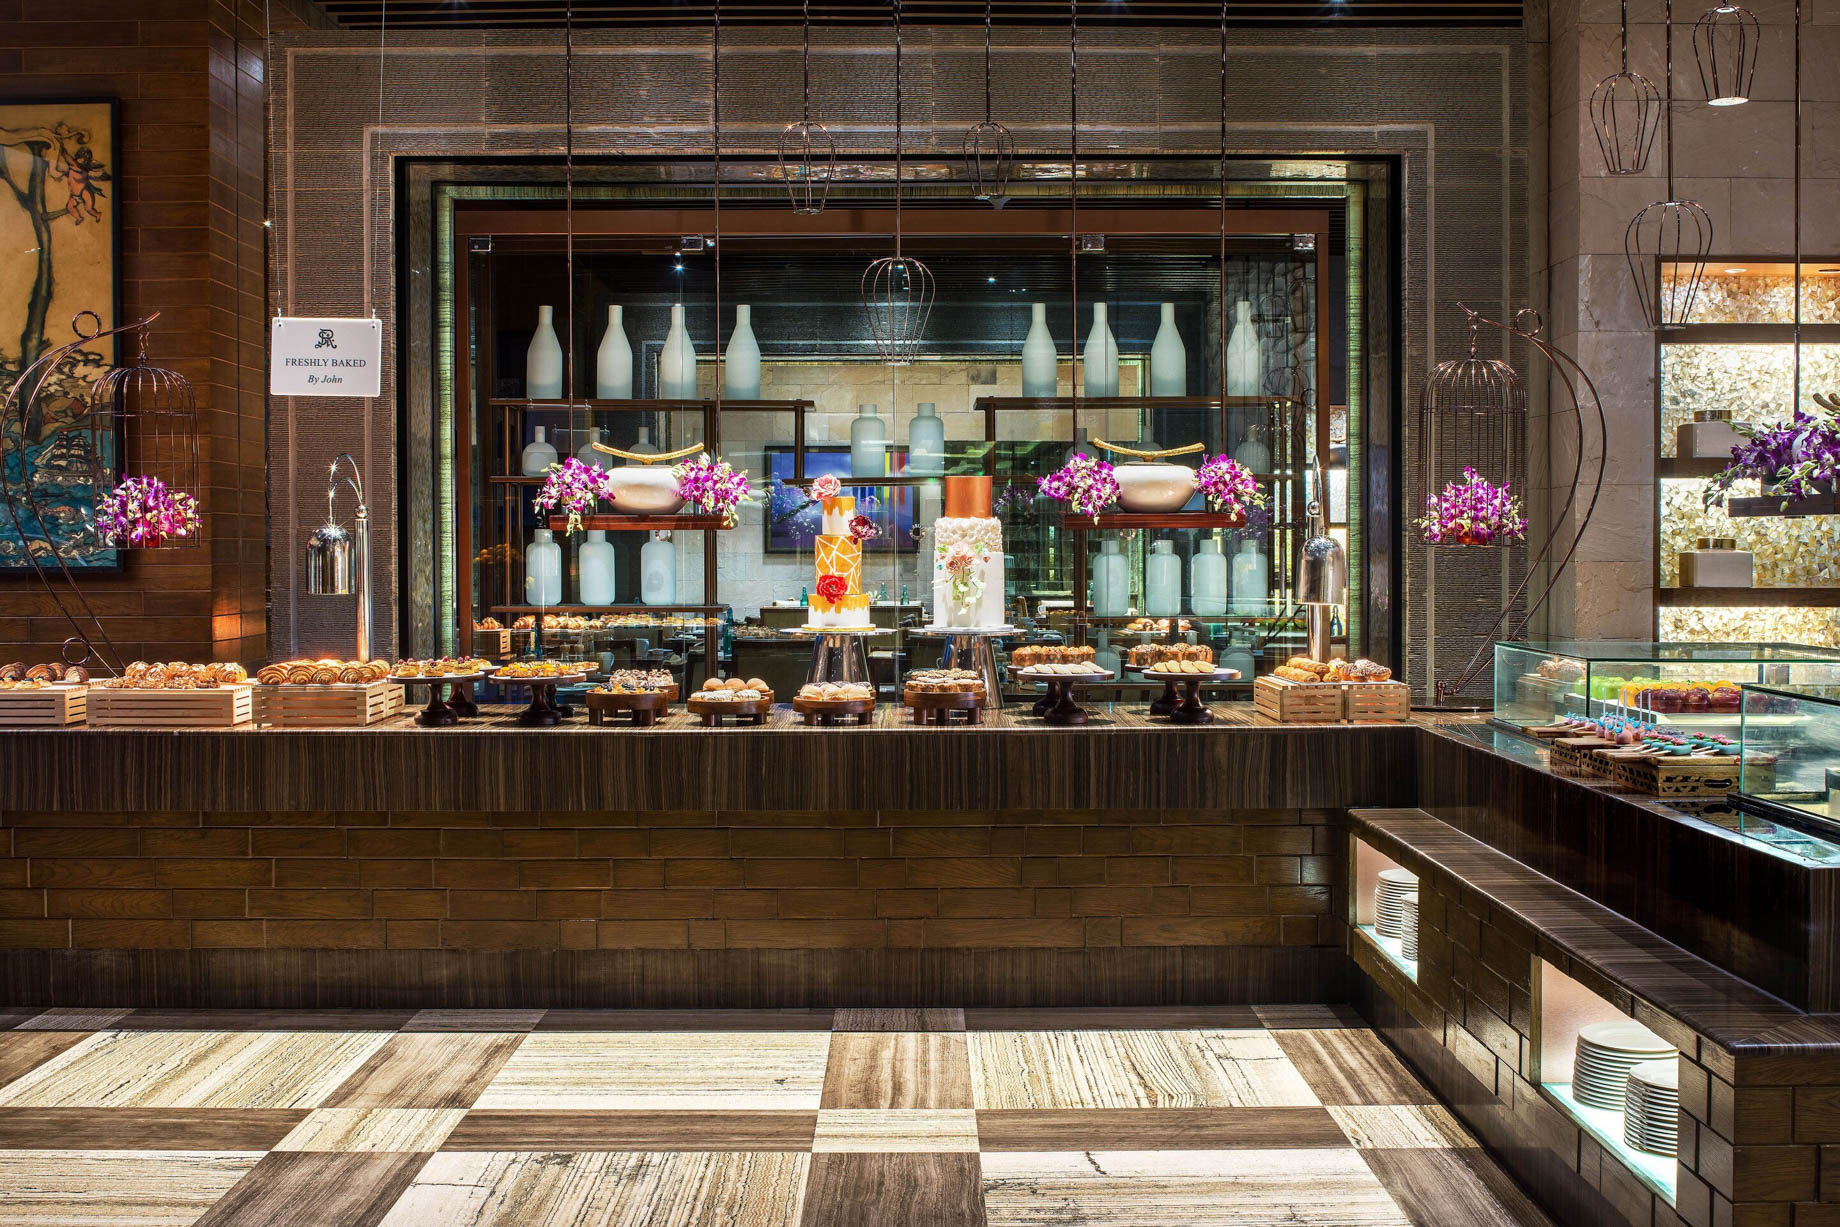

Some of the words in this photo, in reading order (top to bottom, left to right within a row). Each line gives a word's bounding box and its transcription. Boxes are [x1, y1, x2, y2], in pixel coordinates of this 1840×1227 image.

[285, 358, 329, 367] FRESHLY
[331, 359, 367, 368] BAKED
[307, 375, 320, 385] By
[321, 375, 343, 384] John
